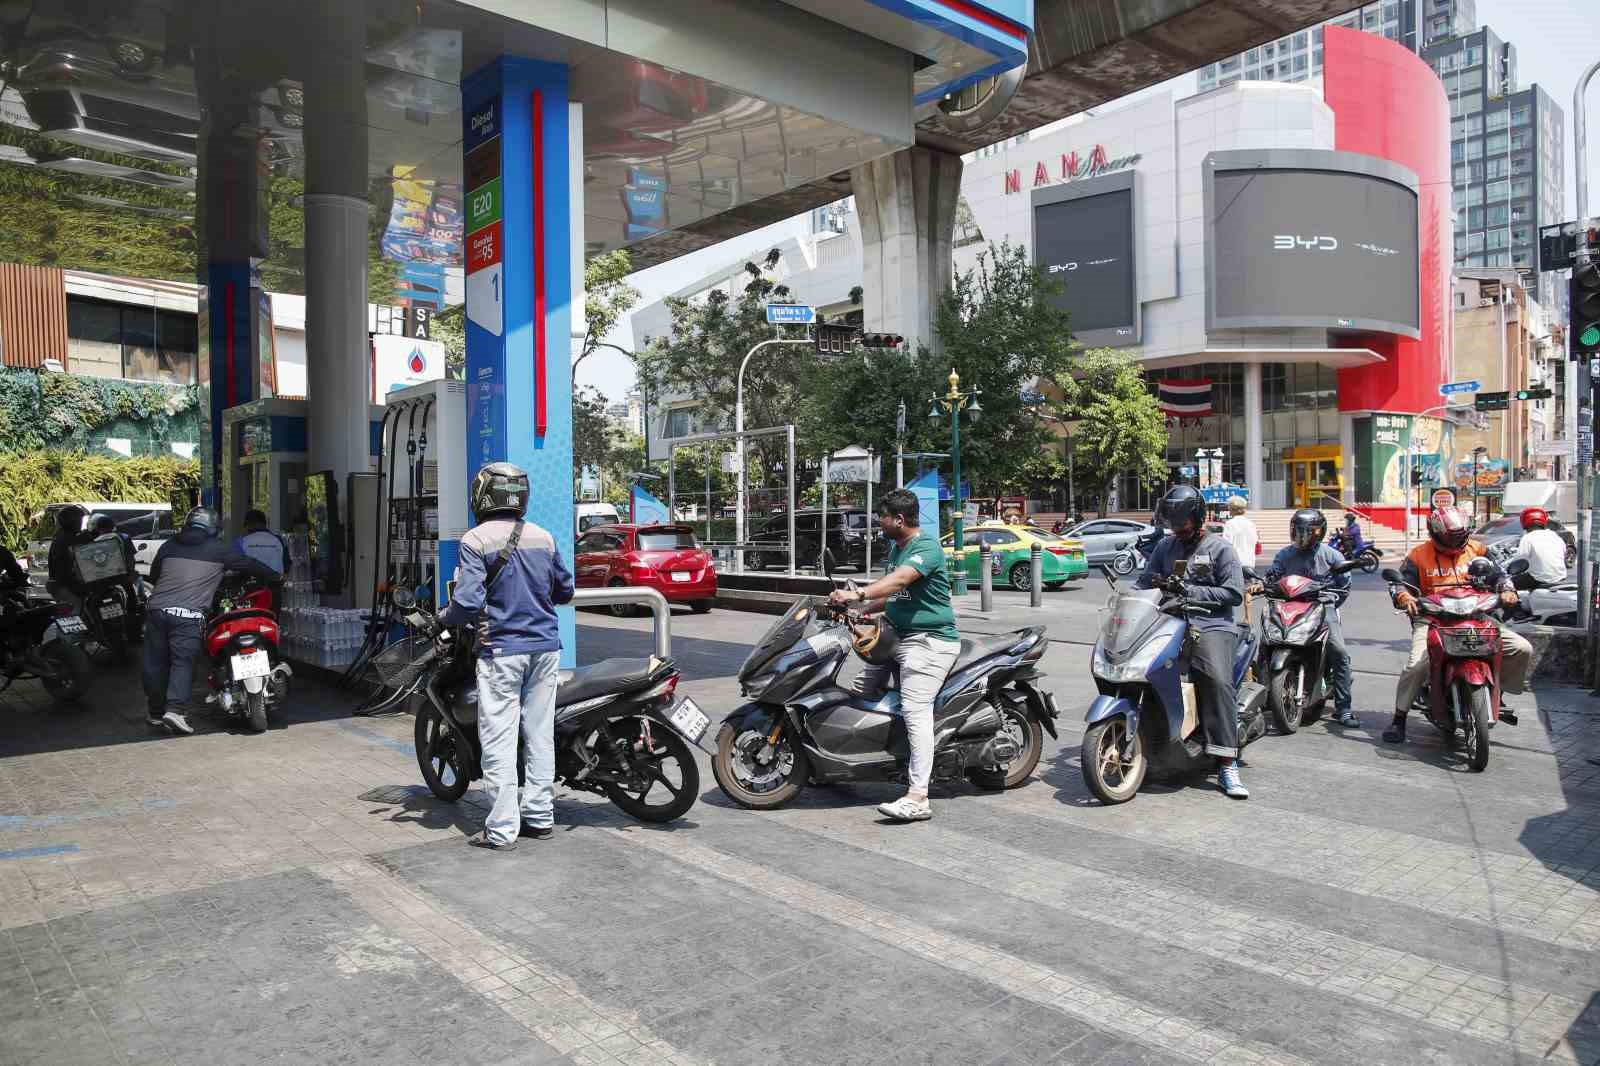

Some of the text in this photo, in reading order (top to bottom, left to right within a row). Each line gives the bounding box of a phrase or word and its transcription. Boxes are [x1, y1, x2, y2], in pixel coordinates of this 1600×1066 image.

[471, 103, 494, 130] Diesel
[1004, 143, 1108, 194] NANA
[473, 190, 493, 217] E20
[482, 243, 493, 262] 95
[1273, 234, 1338, 251] BYD
[1048, 262, 1078, 273] BYD
[491, 272, 500, 302] 1
